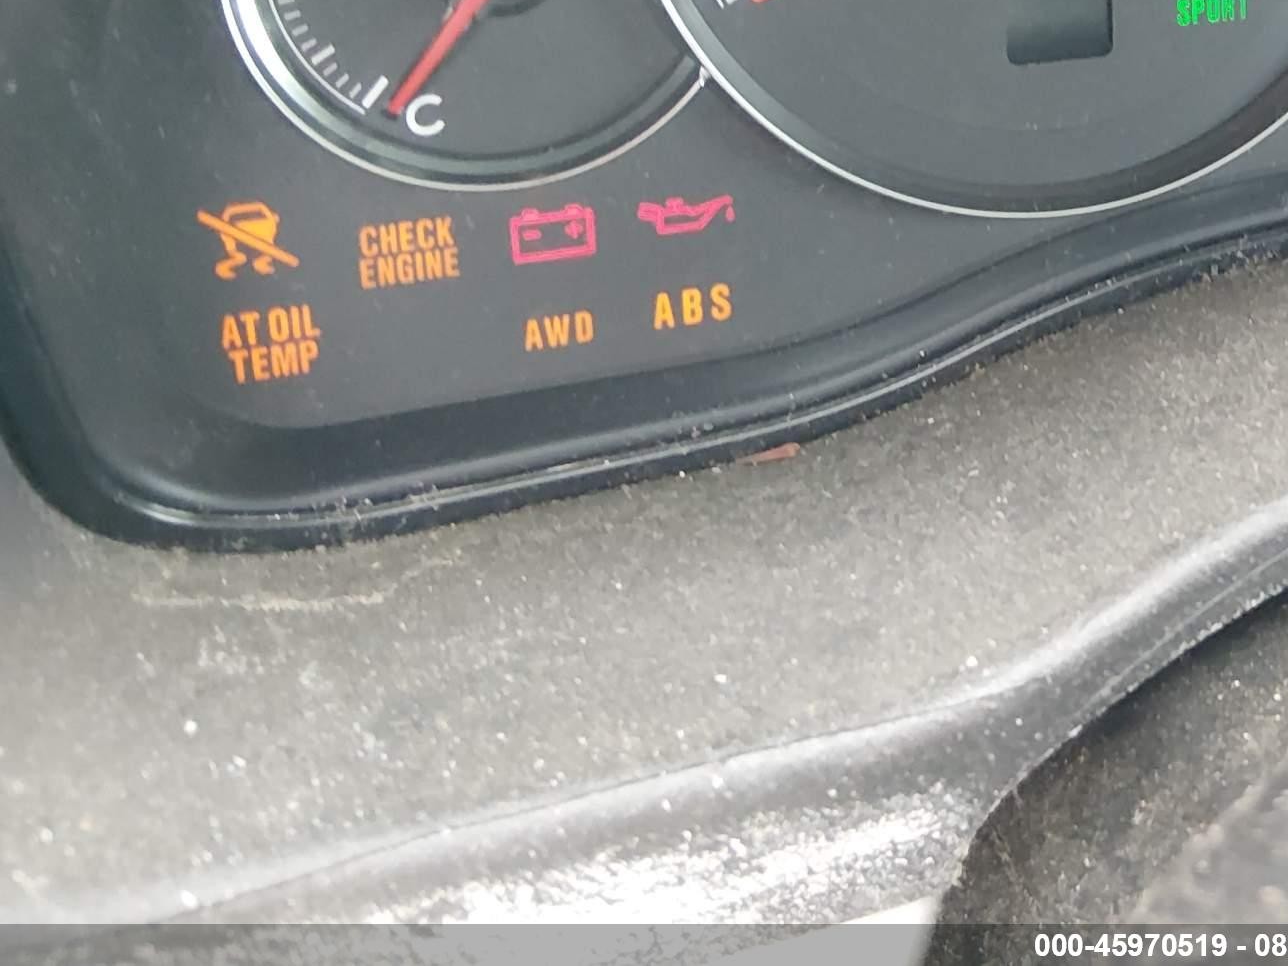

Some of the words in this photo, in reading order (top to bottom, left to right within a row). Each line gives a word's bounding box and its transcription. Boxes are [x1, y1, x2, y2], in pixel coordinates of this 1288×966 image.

[405, 94, 446, 136] C
[359, 217, 455, 258] CHECK
[359, 248, 460, 290] ENGINE
[220, 312, 259, 348] AT
[267, 305, 321, 340] OIL
[653, 284, 732, 330] ABS
[524, 311, 595, 352] AWD
[228, 343, 319, 384] TEMP
